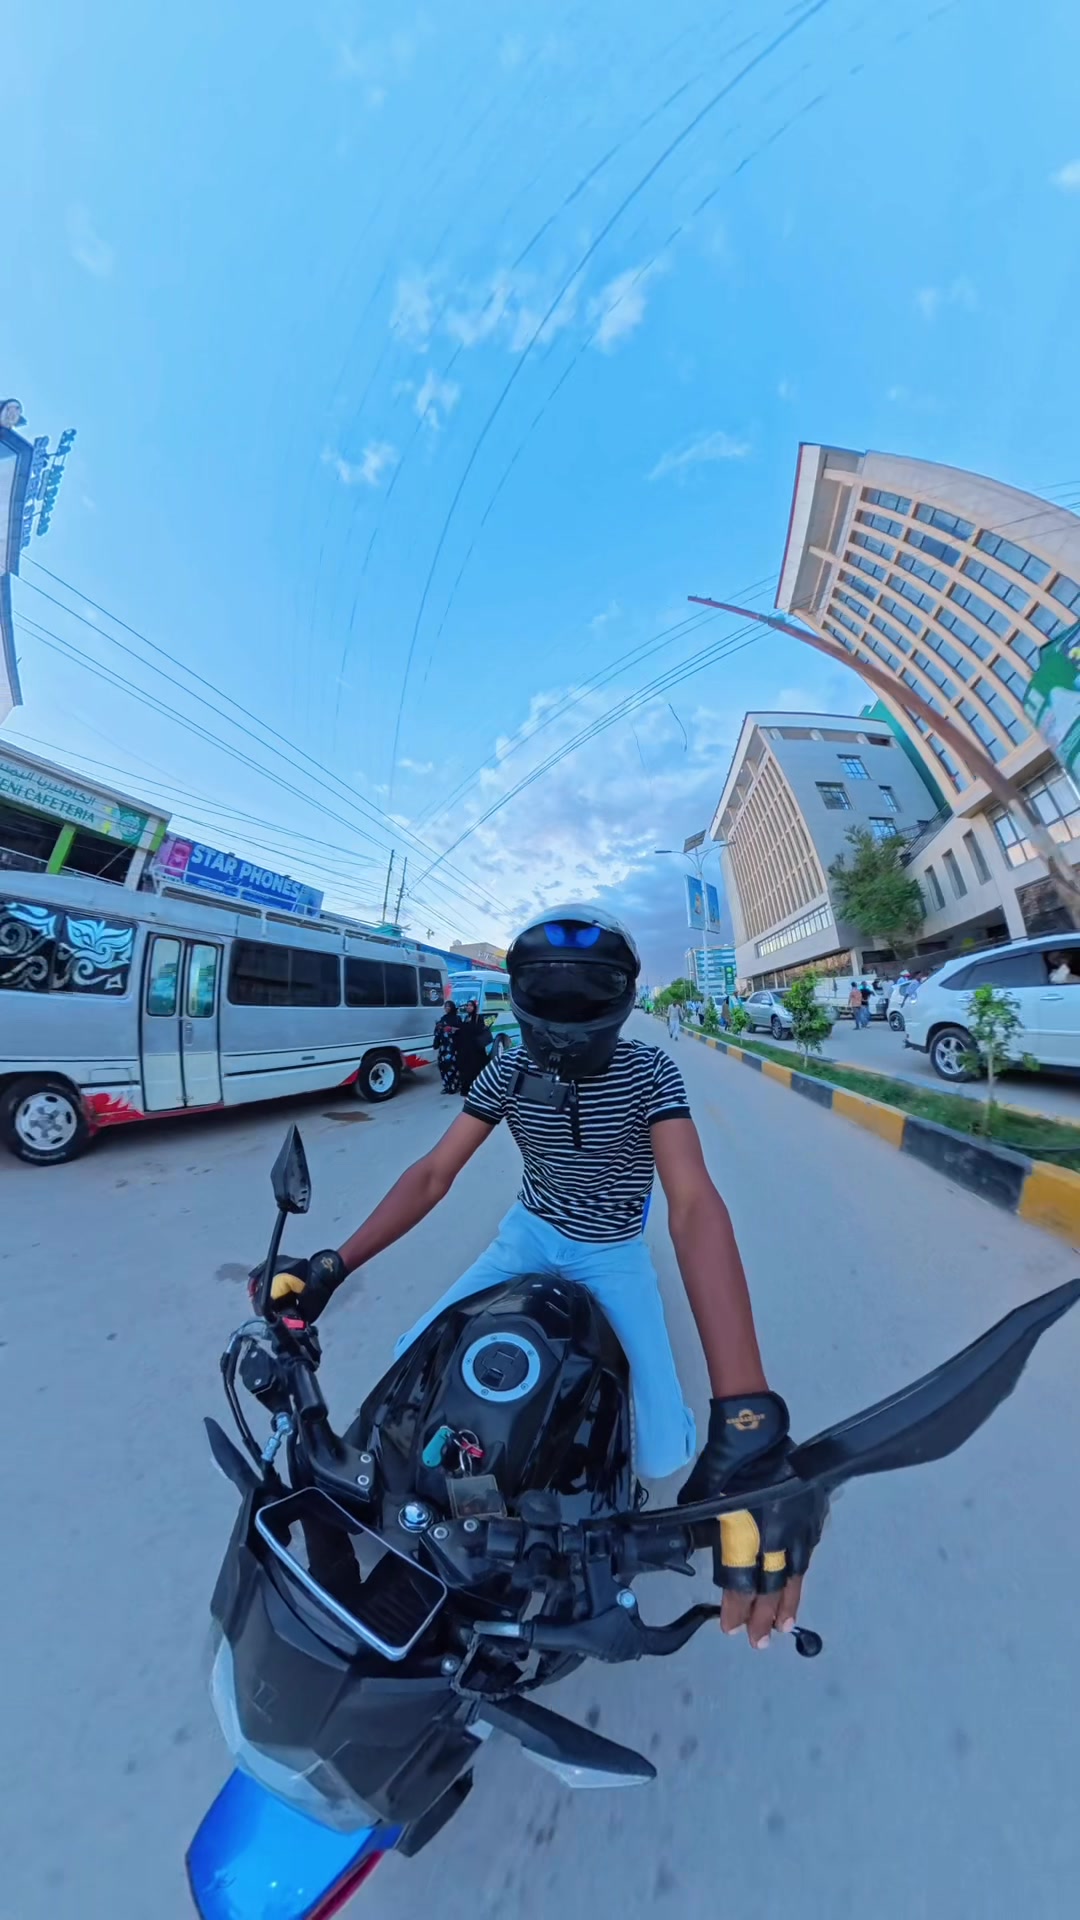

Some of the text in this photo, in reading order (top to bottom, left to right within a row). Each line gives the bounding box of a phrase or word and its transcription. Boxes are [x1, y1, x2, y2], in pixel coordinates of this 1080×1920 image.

[0, 777, 94, 822] ENI CAFETERIA
[191, 844, 237, 875] STAR
[239, 863, 300, 898] PHONES
